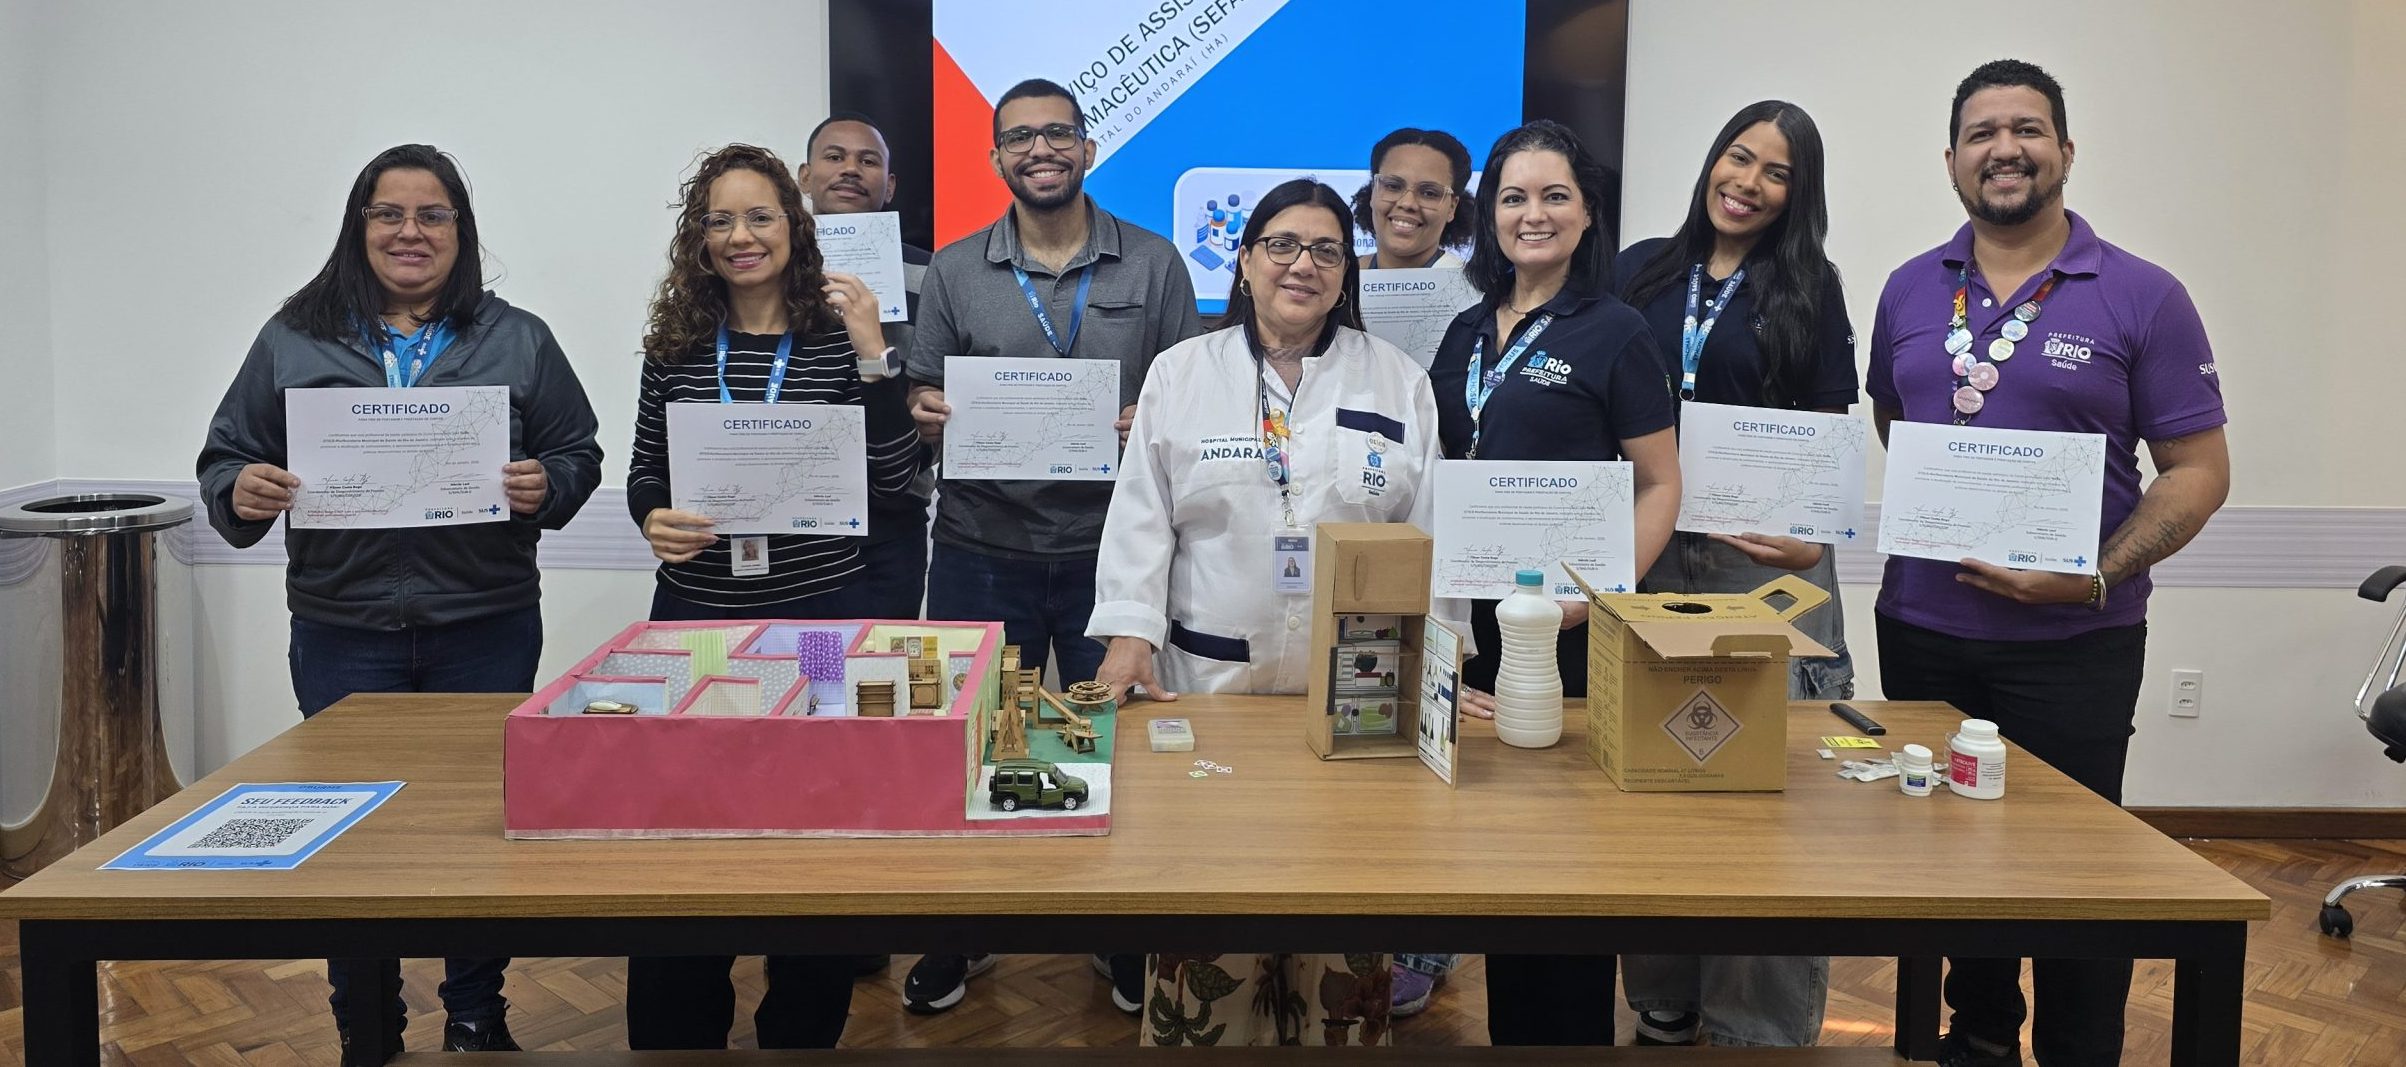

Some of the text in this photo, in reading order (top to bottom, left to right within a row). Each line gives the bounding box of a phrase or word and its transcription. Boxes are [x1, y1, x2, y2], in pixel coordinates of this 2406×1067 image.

[1106, 34, 1139, 66] DE
[1125, 106, 1142, 123] DO
[1146, 57, 1197, 106] ANDARAÍ
[1201, 33, 1228, 59] (HA)
[1083, 36, 1190, 133] MACÊUTICA
[1363, 281, 1436, 292] CERTIFICADO
[1037, 312, 1054, 337] SAÚDE
[1530, 325, 1543, 340] RIO
[2048, 331, 2095, 345] PREFEITURA
[2062, 343, 2091, 360] RIO
[1544, 357, 1572, 375] Rio
[2051, 358, 2077, 371] Saúde
[994, 371, 1073, 382] CERTIFICADO
[1521, 366, 1568, 382] PREFEITURA
[351, 403, 450, 415] CERTIFICADO
[723, 419, 812, 430] CERTIFICADO
[1733, 421, 1816, 437] CERTIFICADO
[1948, 441, 2044, 458] CERTIFICADO
[1057, 466, 1073, 474] RIO
[1362, 470, 1386, 488] RIO
[1489, 477, 1578, 488] CERTIFICADO
[434, 510, 454, 519] RIO
[801, 520, 817, 528] RIO
[1797, 526, 1814, 536] RIO
[2017, 553, 2037, 563] RIO
[1563, 585, 1581, 595] RIO
[1683, 675, 1722, 685] PERIGO
[271, 797, 353, 805] FEEDBACK
